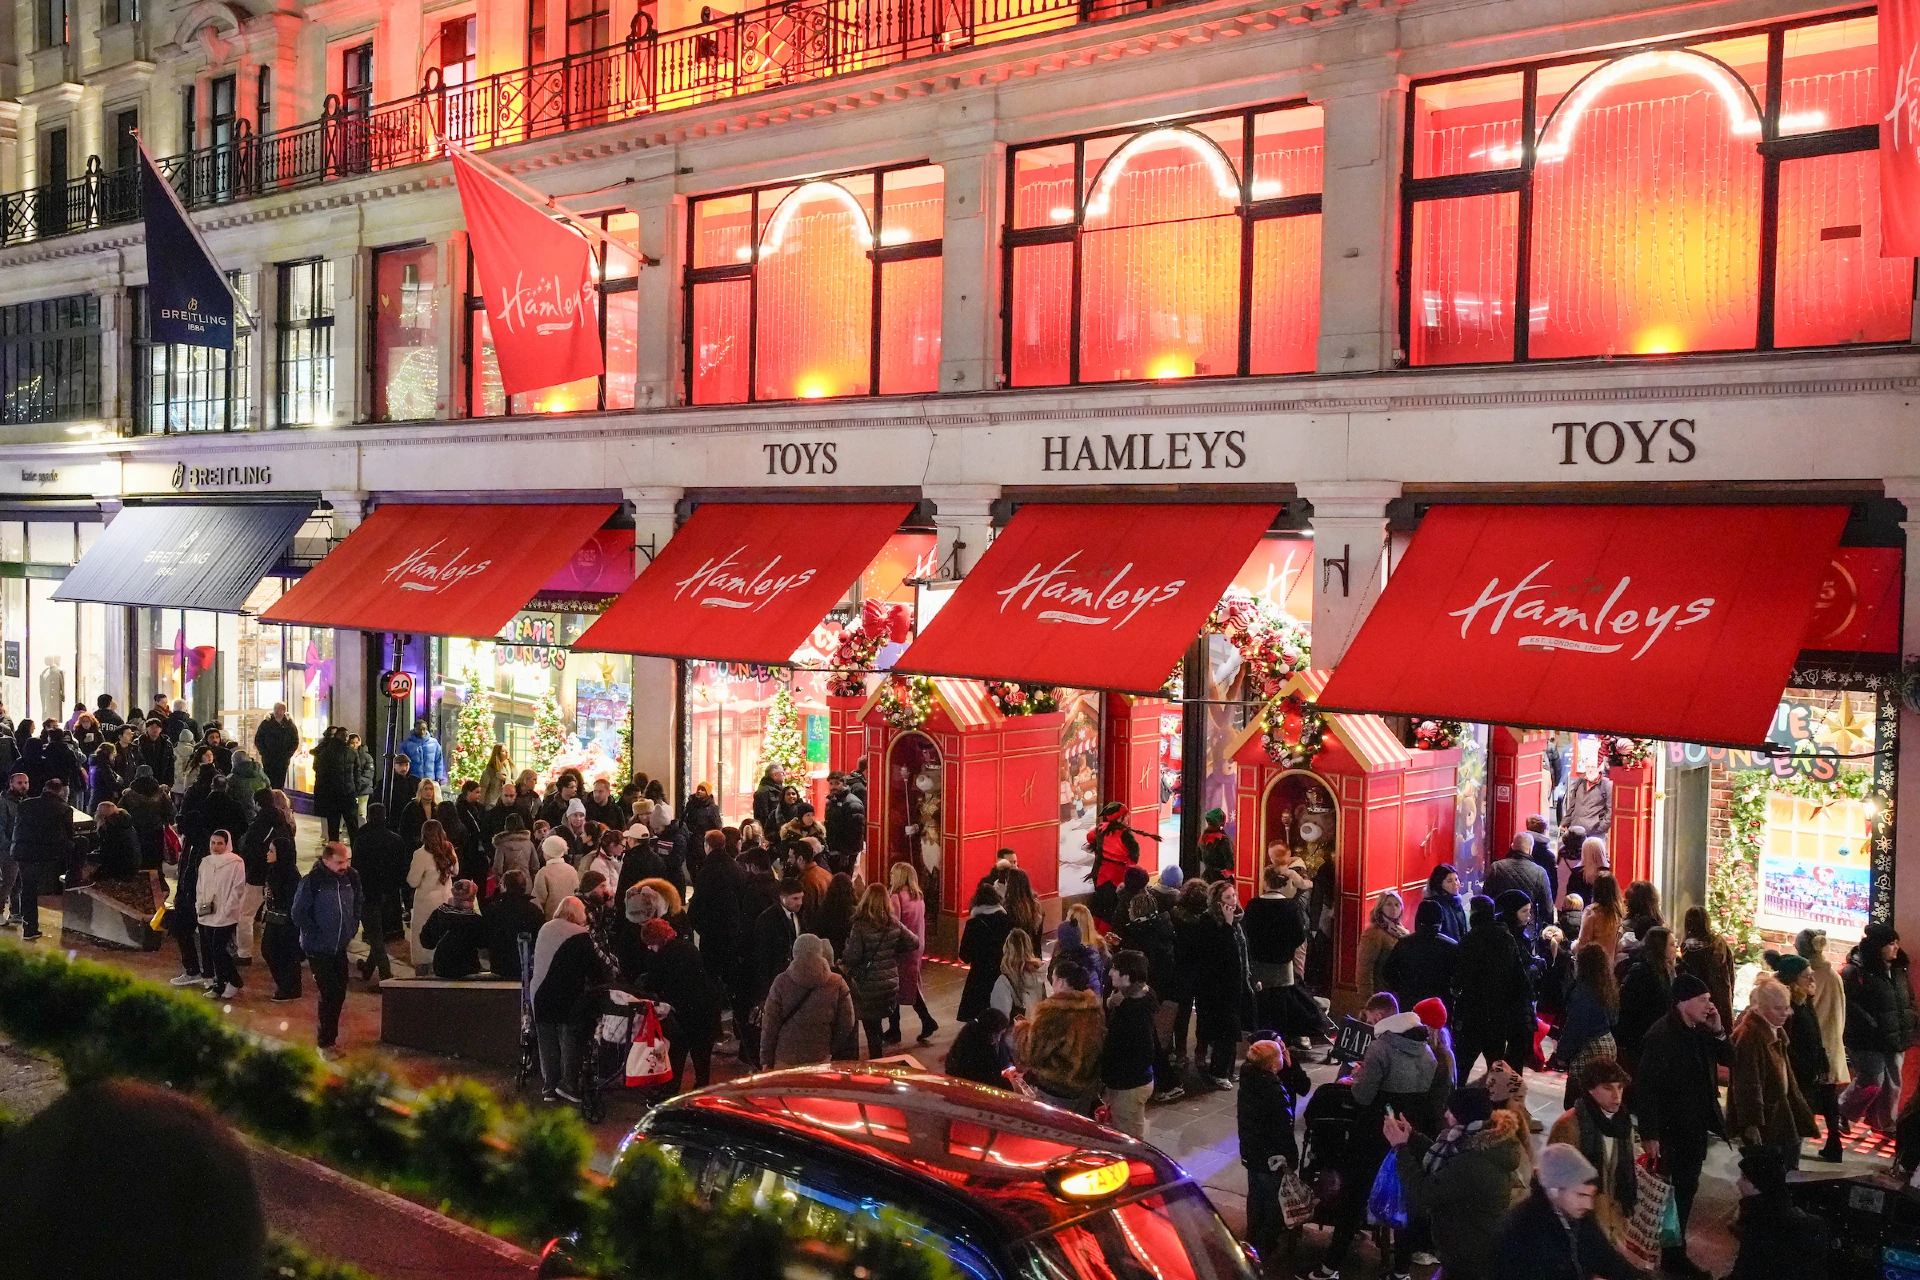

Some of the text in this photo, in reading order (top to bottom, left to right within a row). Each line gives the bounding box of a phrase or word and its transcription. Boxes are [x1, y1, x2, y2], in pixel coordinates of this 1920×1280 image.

[496, 269, 594, 334] Hamleys
[161, 309, 227, 325] BREITLING
[187, 323, 205, 332] 1884
[1041, 430, 1247, 471] HAMLEYS
[1551, 418, 1697, 465] TOYS
[762, 442, 838, 475] TOYS
[189, 466, 272, 486] BREITLING
[144, 550, 211, 564] BREITLING
[382, 537, 492, 595] Hamleys
[674, 544, 817, 613] Hamleys
[996, 549, 1186, 630] Hamleys
[1448, 559, 1716, 661] Hamleys
[505, 615, 555, 643] BEANIE
[811, 622, 840, 651] ty
[1548, 638, 1581, 649] LONDON
[496, 643, 566, 670] BOUNCERS
[393, 680, 409, 689] 20
[1340, 1026, 1372, 1055] GAP
